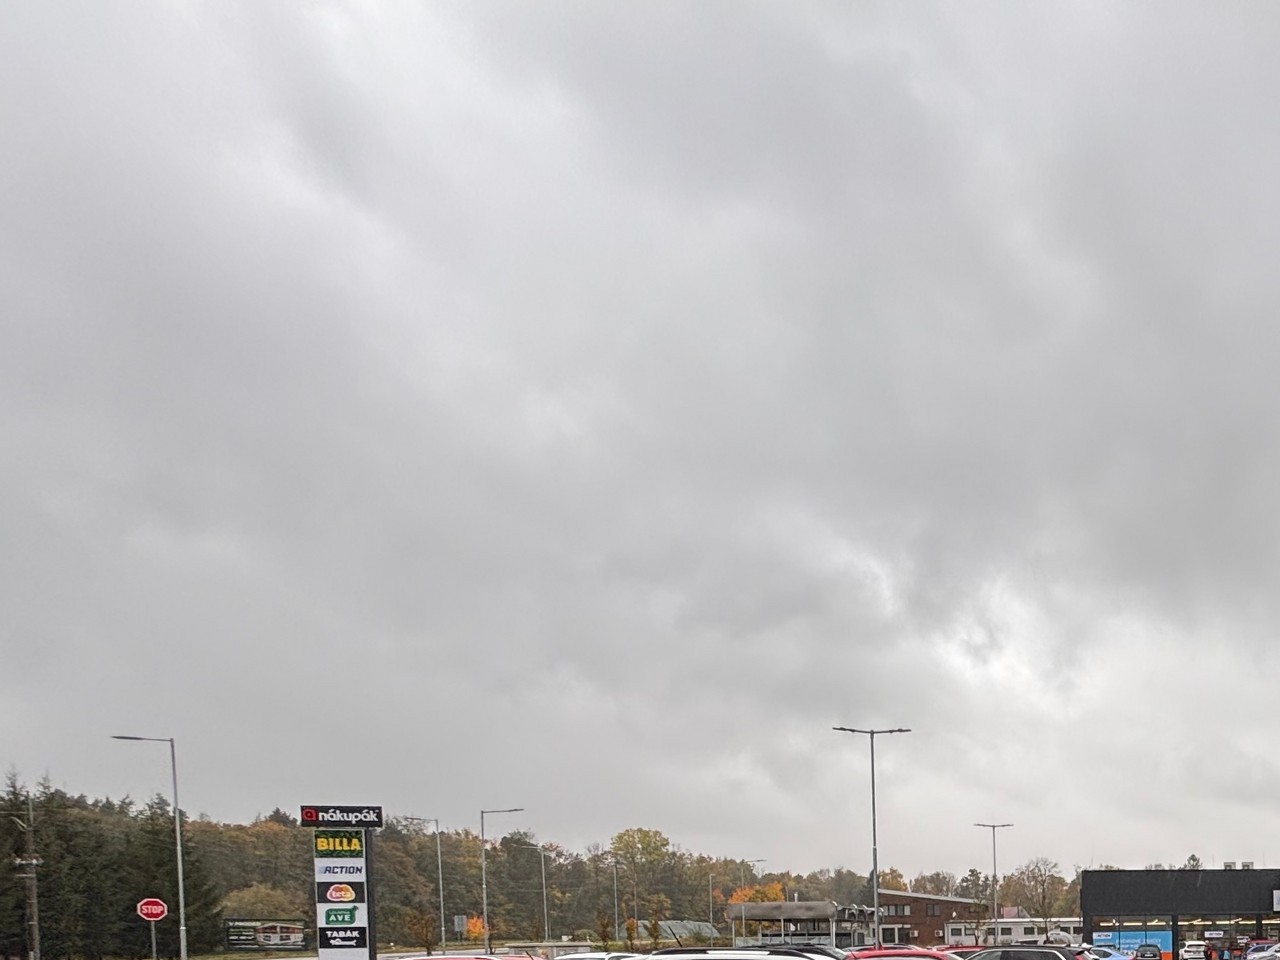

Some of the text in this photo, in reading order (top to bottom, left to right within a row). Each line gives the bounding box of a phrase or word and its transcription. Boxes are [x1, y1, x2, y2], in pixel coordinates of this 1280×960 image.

[318, 808, 379, 824] nákupák
[316, 837, 361, 851] BILLA
[323, 866, 363, 875] ACTION
[332, 890, 352, 900] teta
[141, 905, 164, 914] STOP
[325, 929, 360, 938] TABÁK
